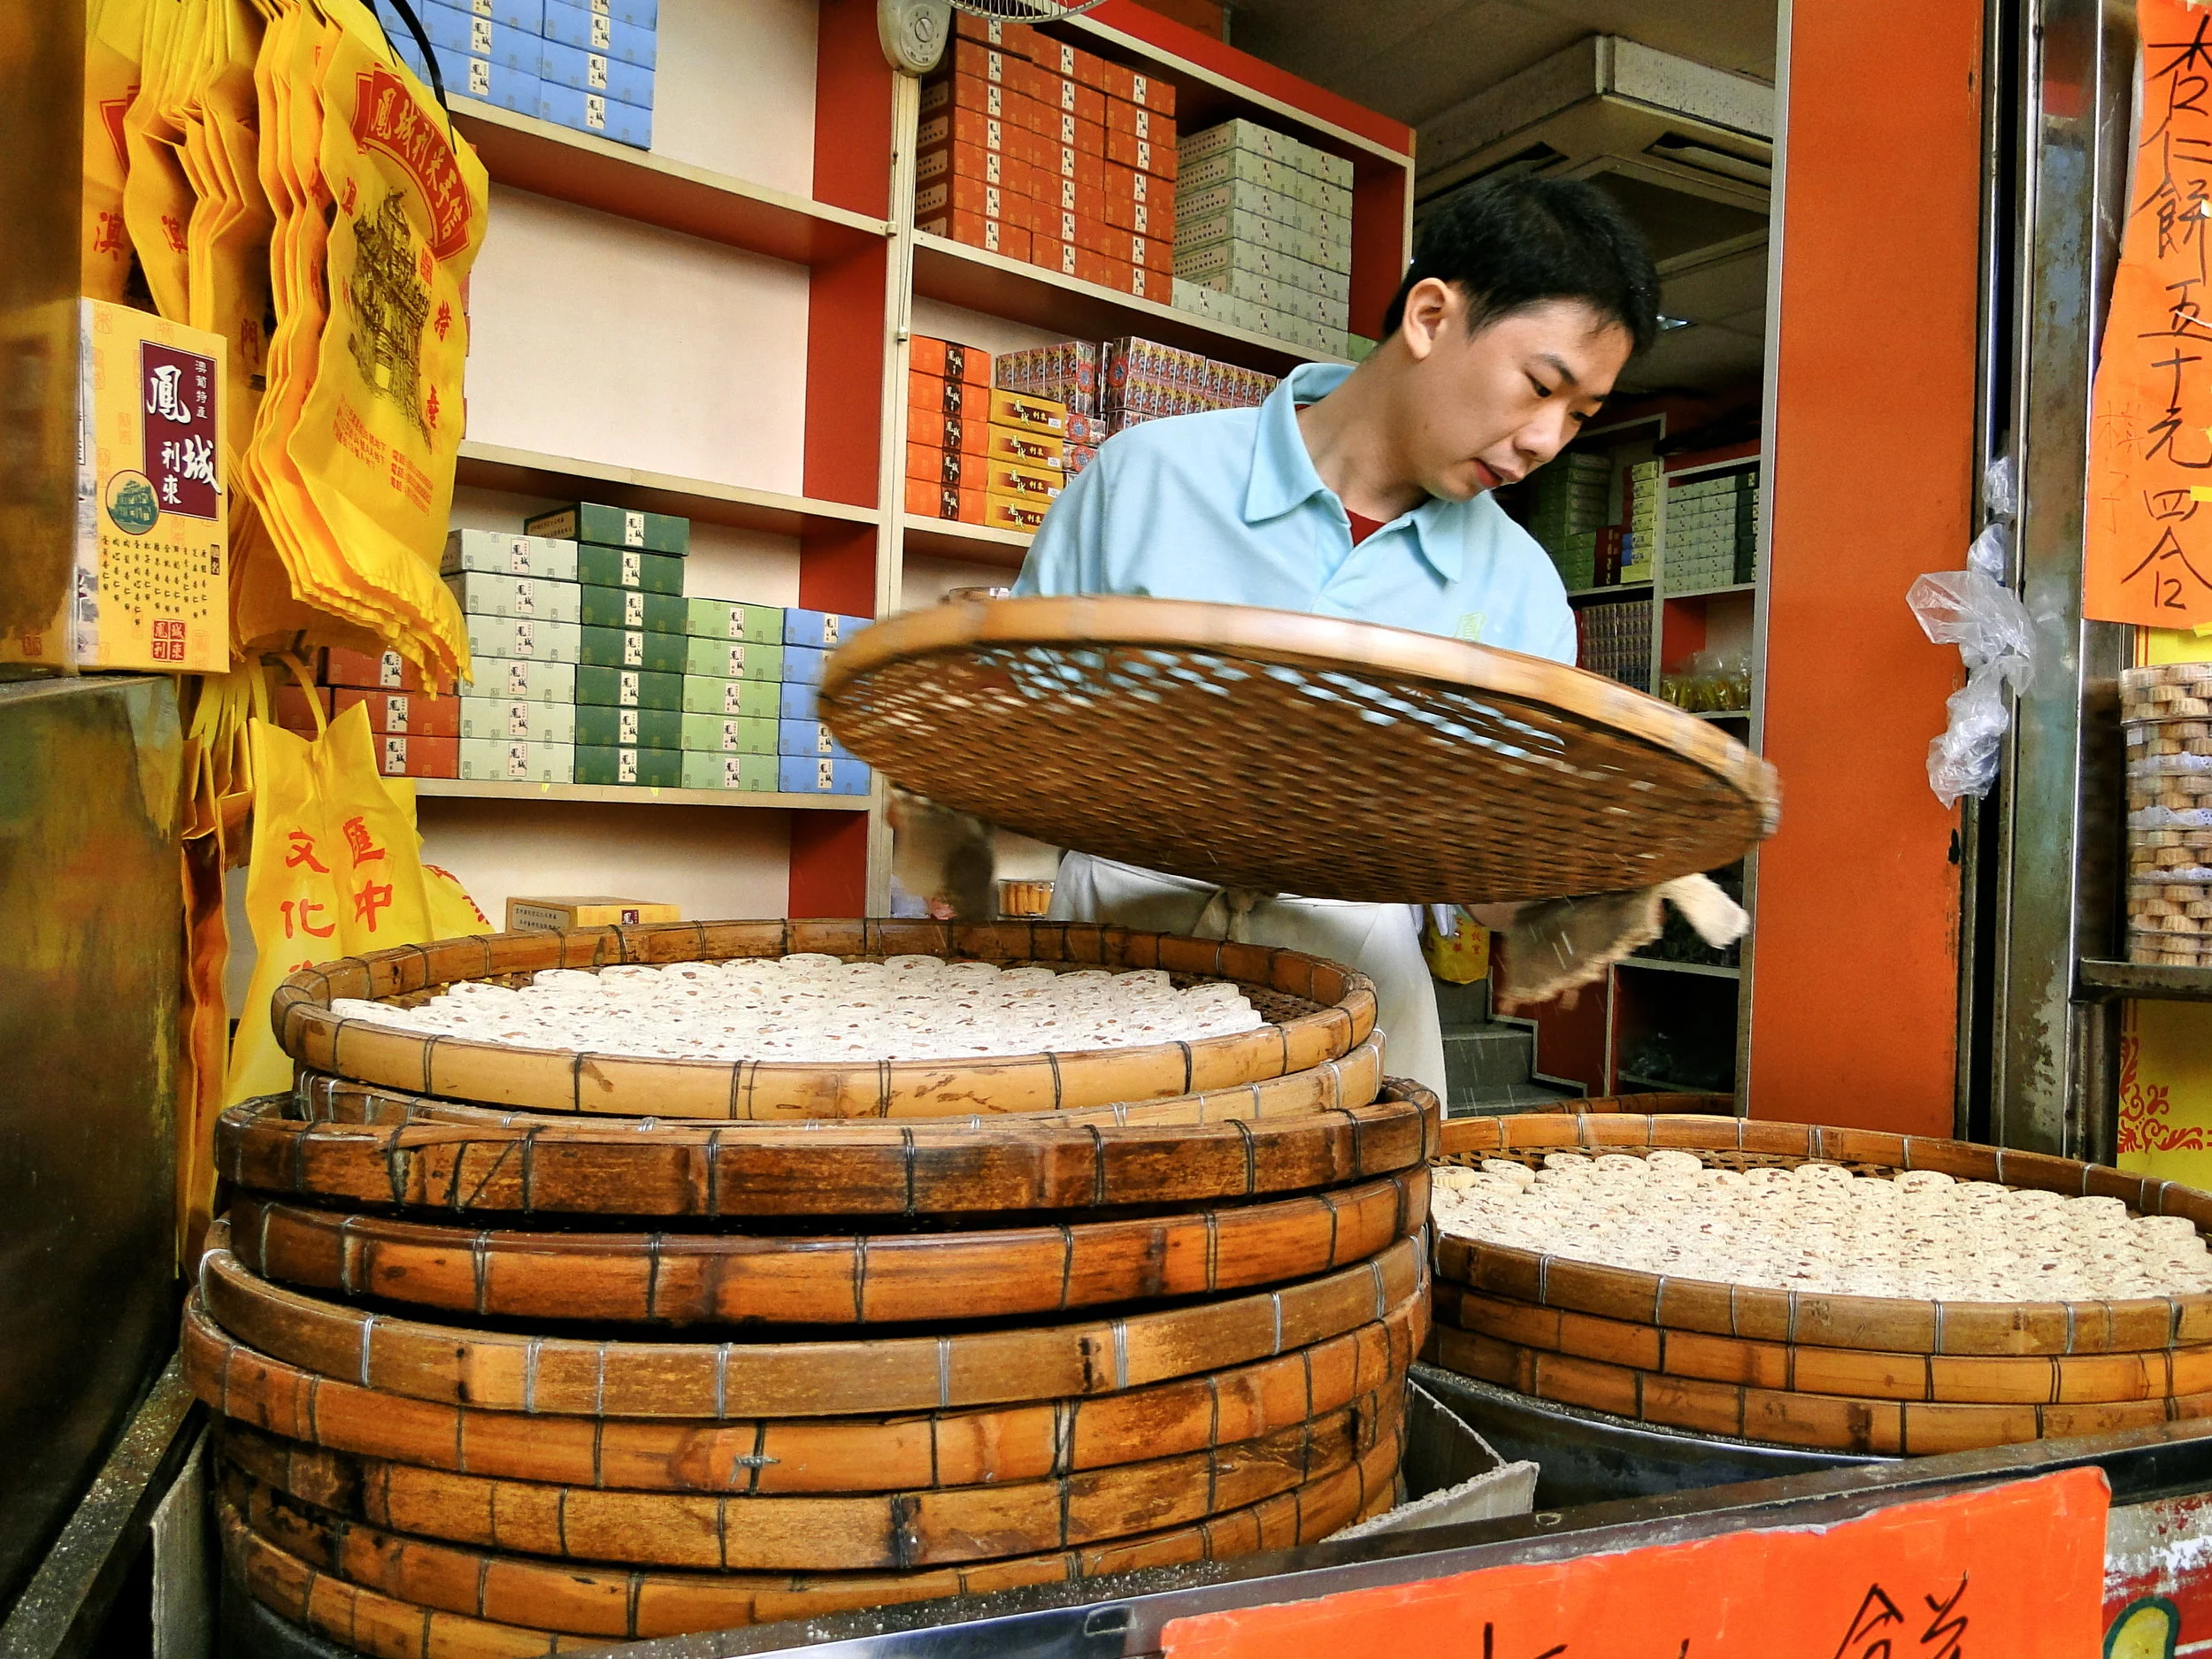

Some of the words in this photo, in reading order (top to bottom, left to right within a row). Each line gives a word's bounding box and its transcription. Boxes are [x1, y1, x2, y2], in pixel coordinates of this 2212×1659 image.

[146, 364, 222, 496] 鳳城
[194, 359, 209, 420] 澳葡特產
[160, 440, 183, 506] 利來
[280, 824, 337, 972] 文化
[342, 815, 393, 933] 匯中
